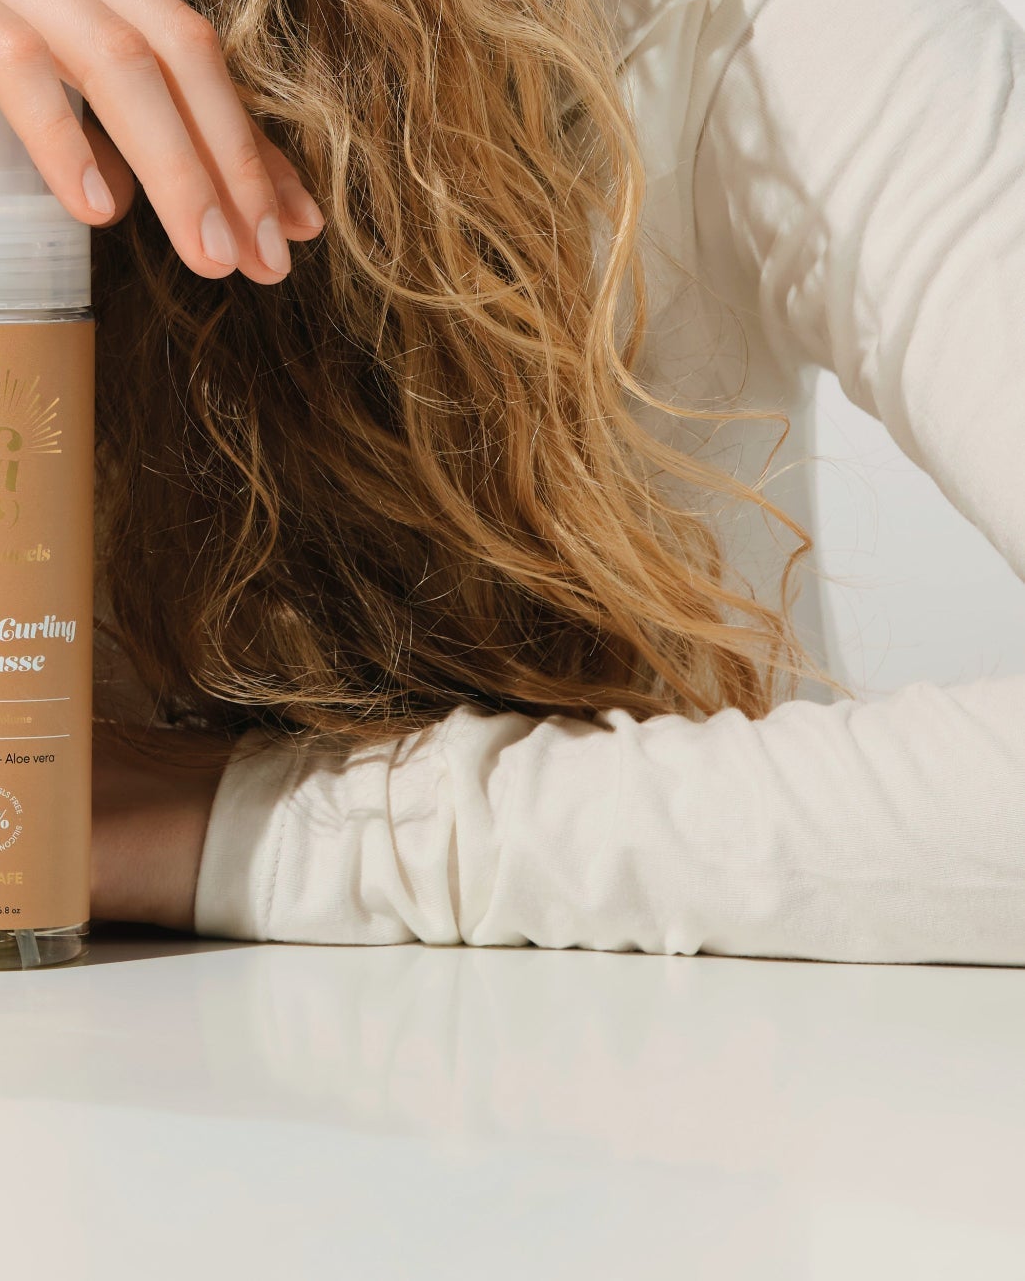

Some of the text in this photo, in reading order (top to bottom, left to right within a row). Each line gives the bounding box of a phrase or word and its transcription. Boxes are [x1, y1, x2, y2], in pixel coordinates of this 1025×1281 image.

[5, 753, 30, 764] Aloe
[32, 754, 55, 763] vera
[9, 795, 23, 815] FREE
